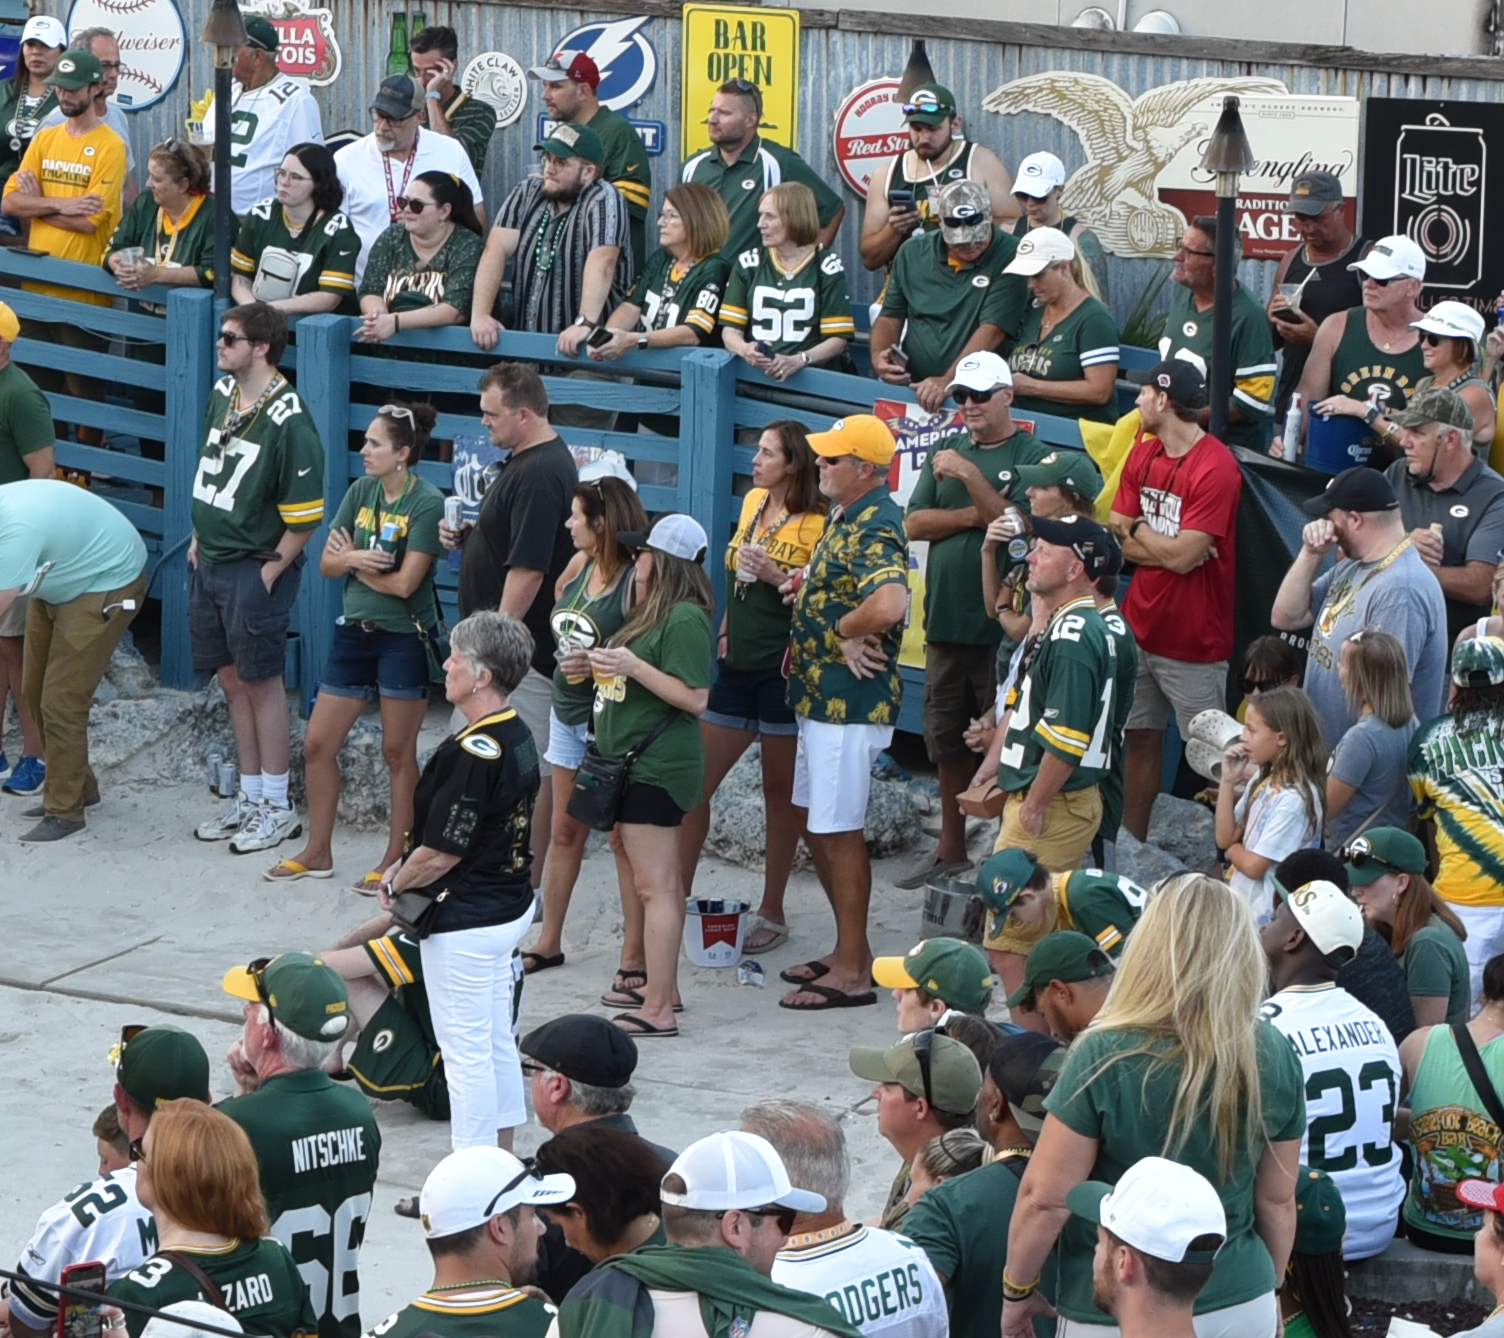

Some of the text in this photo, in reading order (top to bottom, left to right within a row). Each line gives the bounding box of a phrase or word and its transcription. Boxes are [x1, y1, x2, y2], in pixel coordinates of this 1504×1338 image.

[714, 18, 767, 53] BAR
[465, 61, 487, 99] WHITE
[486, 56, 519, 79] CLAW
[707, 51, 772, 87] OPEN
[846, 133, 910, 157] Red Str
[1400, 153, 1479, 205] Lite
[1236, 198, 1290, 212] RADITIO
[1238, 211, 1302, 242] AGE
[695, 290, 719, 314] 80
[751, 285, 816, 343] 52
[266, 392, 303, 427] 27
[192, 427, 261, 512] 27
[1049, 614, 1086, 643] 12
[1104, 614, 1127, 637] 3
[1287, 1020, 1386, 1058] ALEXANDER
[1304, 1060, 1396, 1172] 23
[291, 1126, 367, 1173] NITSCHKE
[129, 1257, 173, 1288] 3
[198, 1272, 274, 1314] ZARD
[828, 1262, 923, 1327] ODGERS
